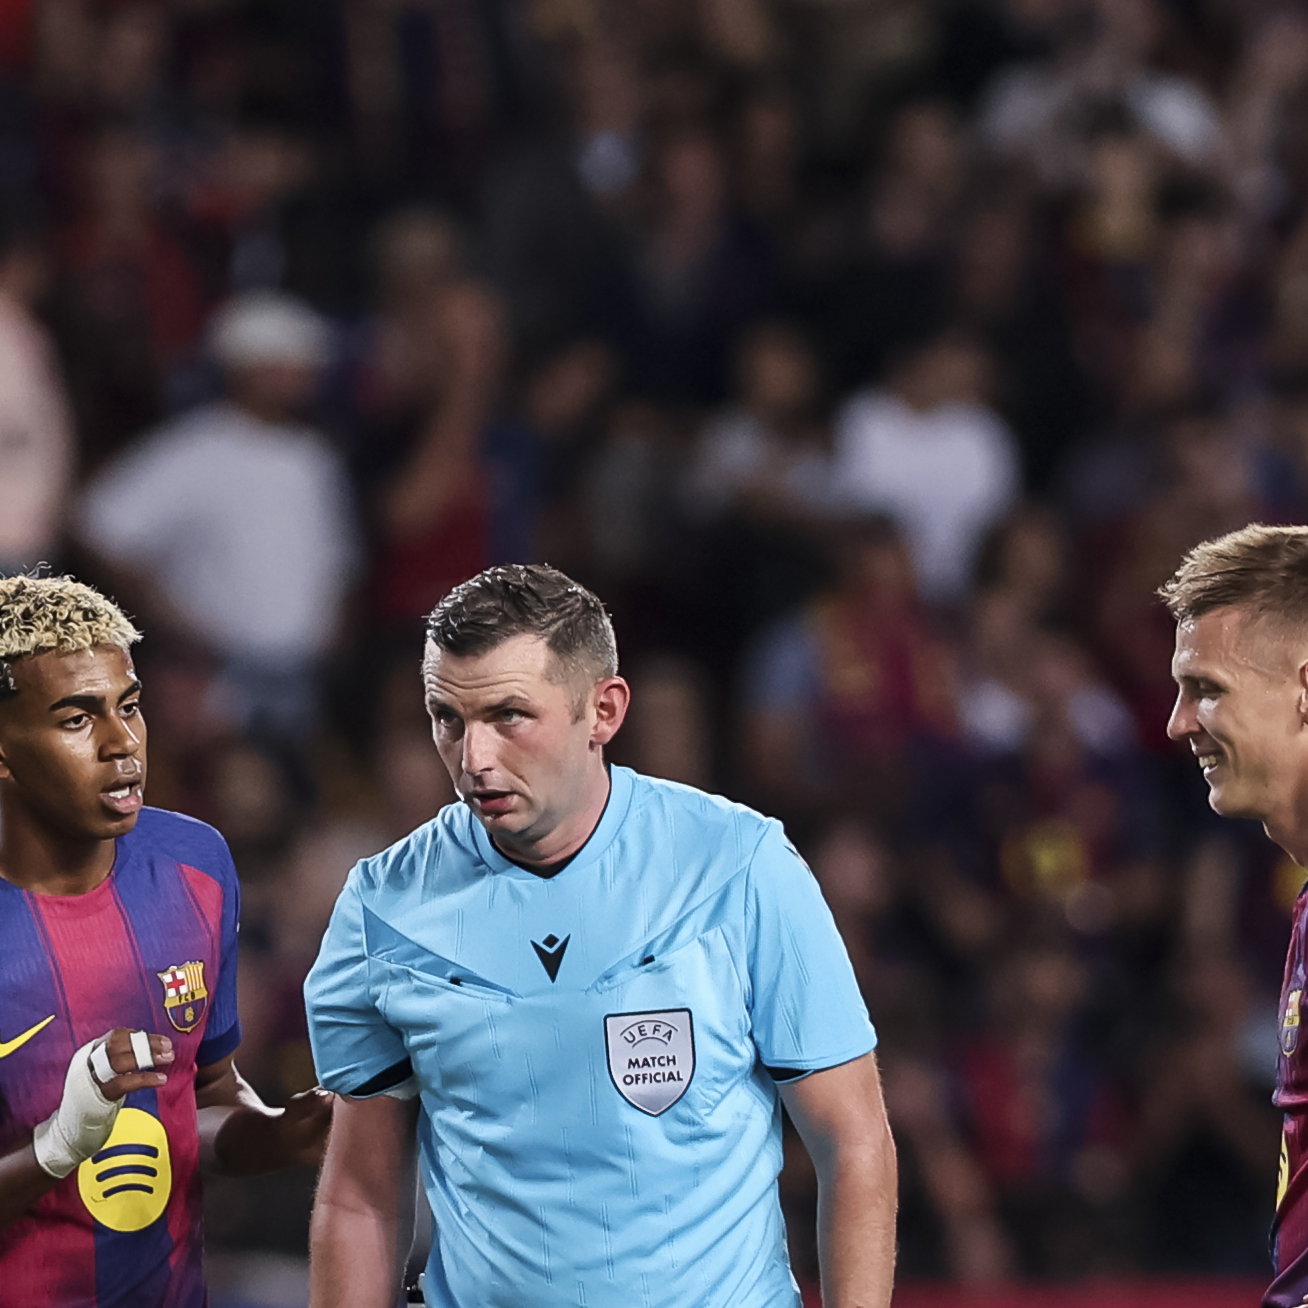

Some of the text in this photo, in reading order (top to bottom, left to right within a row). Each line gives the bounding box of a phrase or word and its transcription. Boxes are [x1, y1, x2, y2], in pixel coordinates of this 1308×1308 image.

[623, 1024, 673, 1044] UEFA
[627, 1055, 677, 1070] MATCH
[622, 1070, 684, 1086] OFFICIAL
